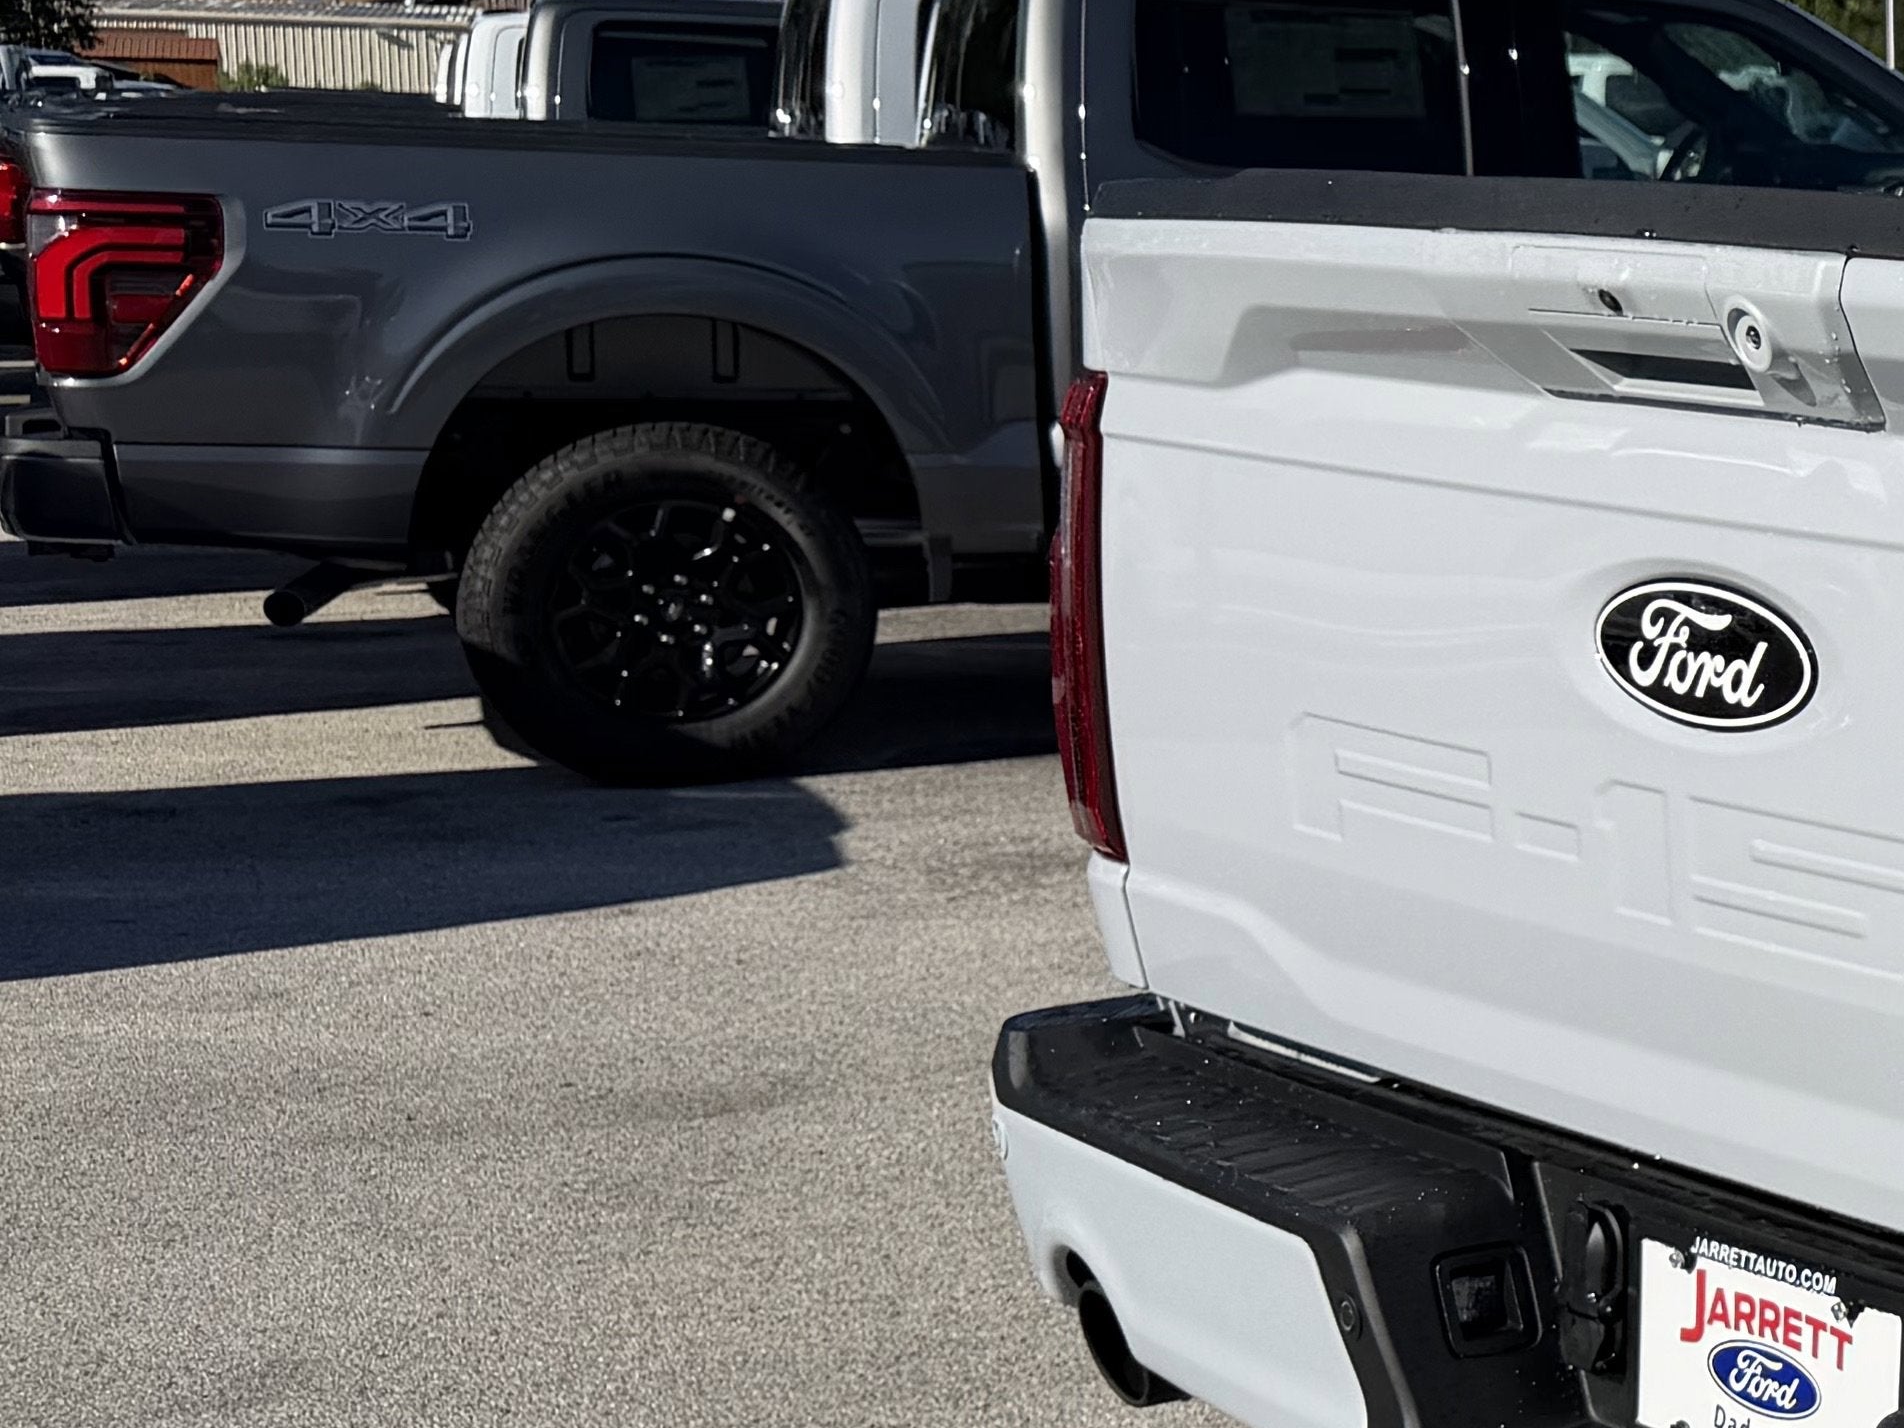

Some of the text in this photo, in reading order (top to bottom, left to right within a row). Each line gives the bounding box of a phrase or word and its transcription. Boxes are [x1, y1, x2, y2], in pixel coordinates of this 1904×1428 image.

[1629, 599, 1768, 707] Ford
[1690, 1236, 1837, 1295] JARRETTAUTO.COM
[1680, 1269, 1853, 1371] JARRETT
[1728, 1349, 1799, 1410] Ford
